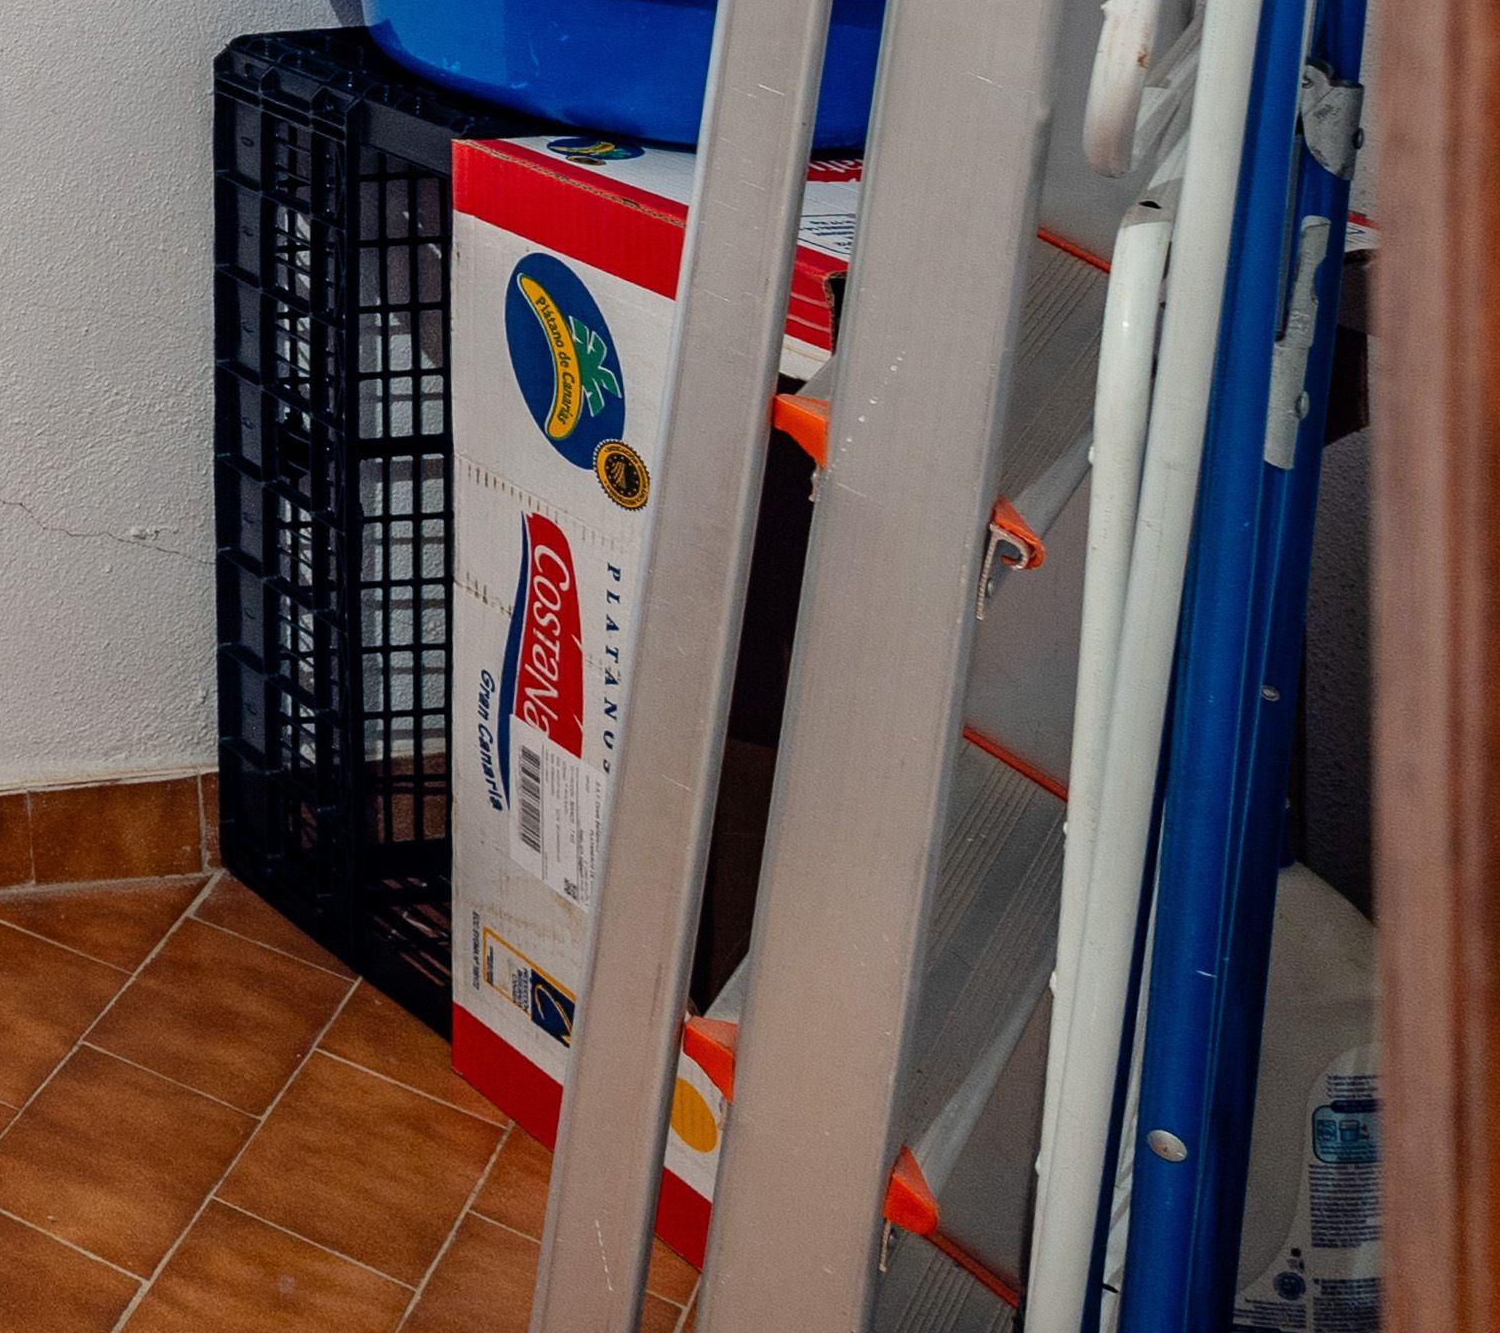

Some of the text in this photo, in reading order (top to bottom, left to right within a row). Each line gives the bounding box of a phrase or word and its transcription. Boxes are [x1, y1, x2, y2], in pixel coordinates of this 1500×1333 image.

[559, 351, 572, 368] de
[476, 669, 504, 812] Gran Canaria
